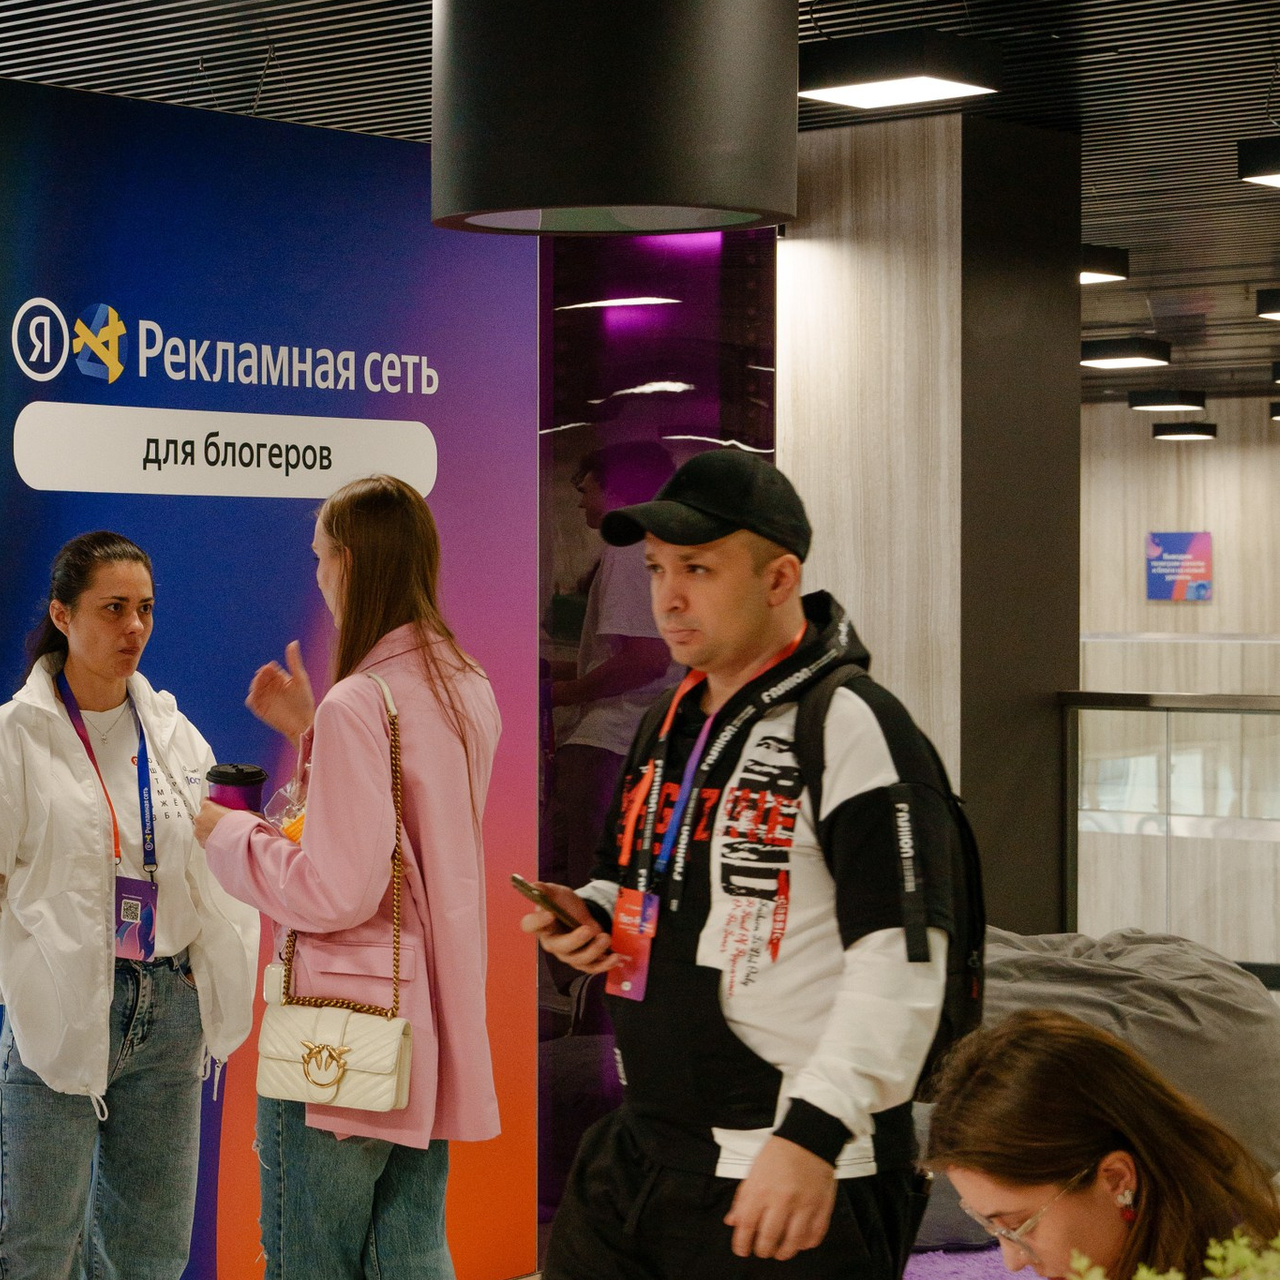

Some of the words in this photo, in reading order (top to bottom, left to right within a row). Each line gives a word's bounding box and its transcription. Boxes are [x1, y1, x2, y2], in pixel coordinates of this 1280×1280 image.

[139, 319, 356, 390] Рекламная
[364, 351, 439, 395] сеть
[142, 436, 195, 470] для
[204, 432, 333, 477] блогеров
